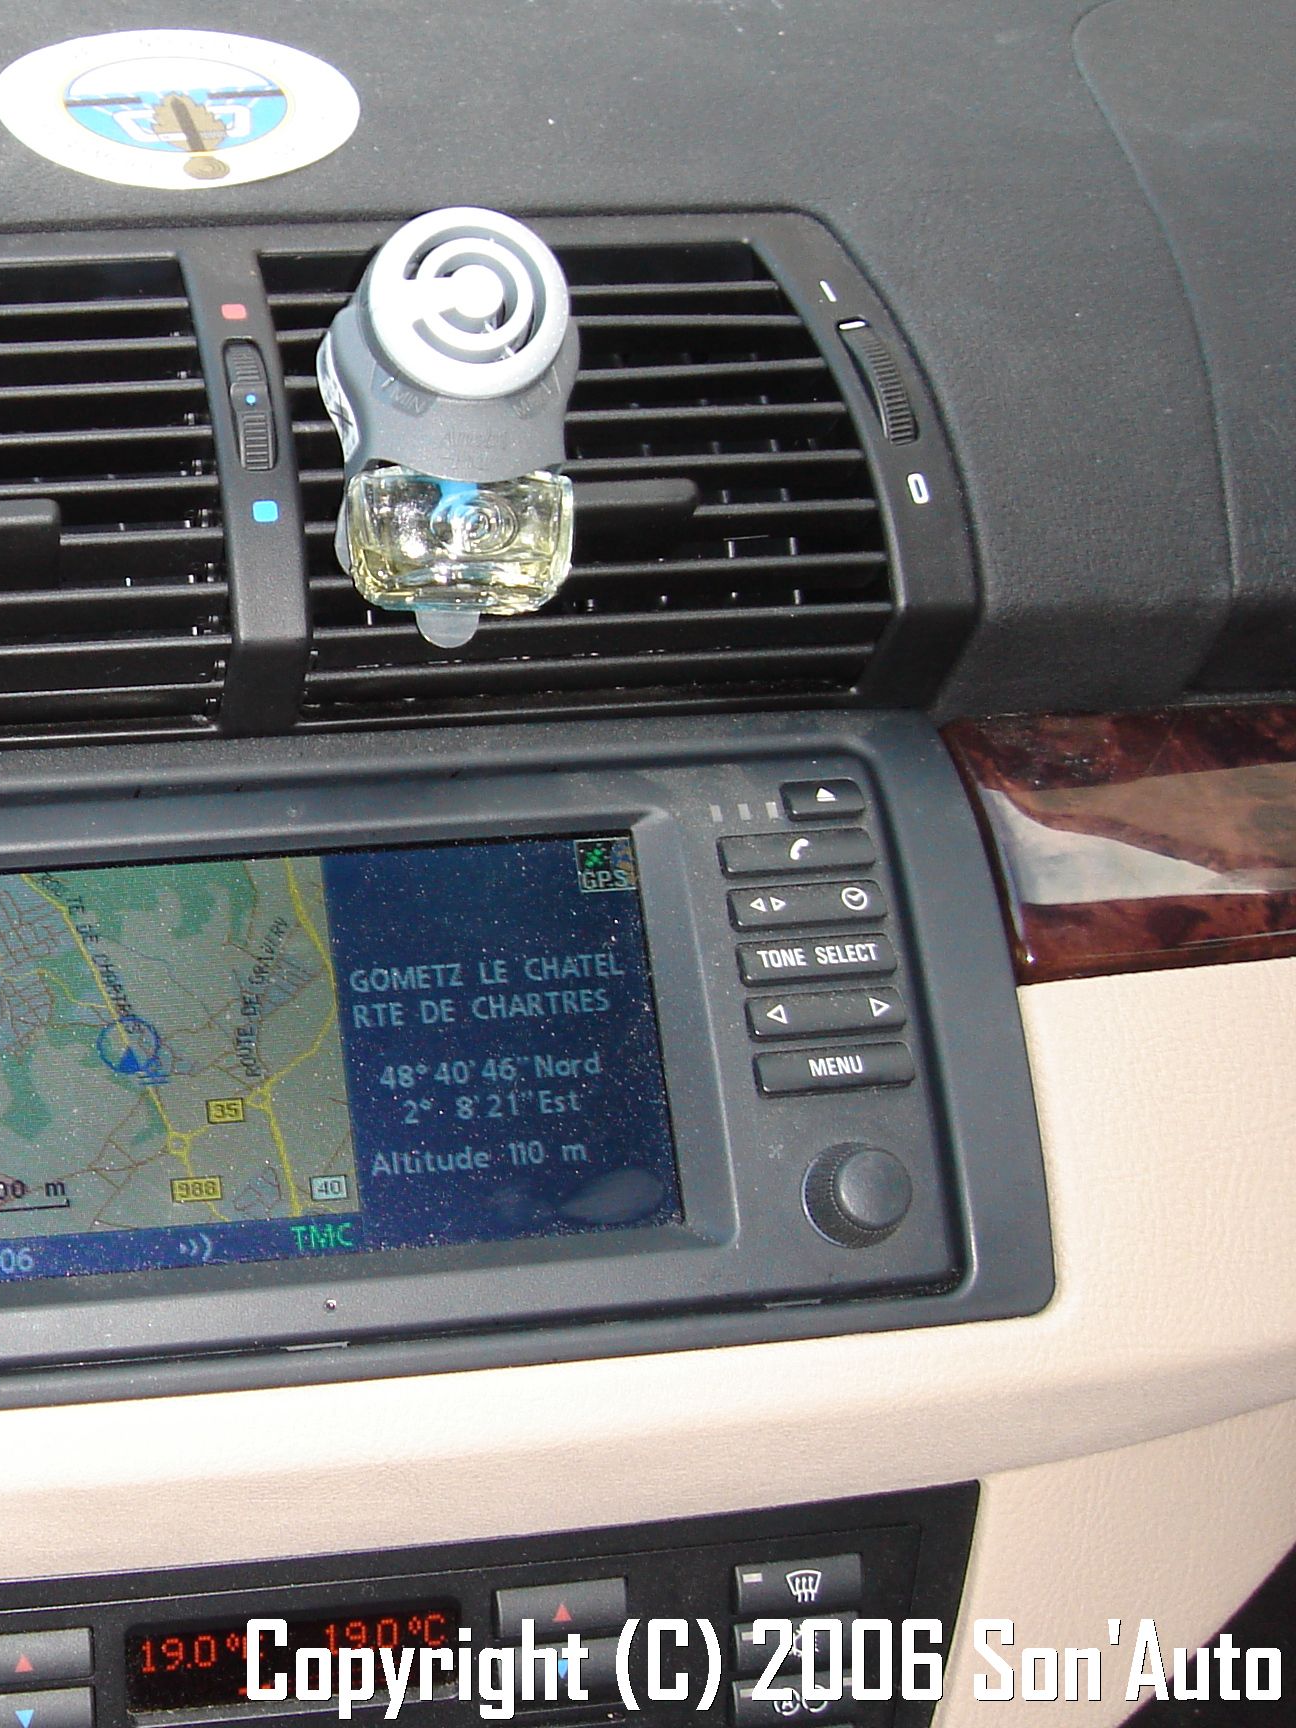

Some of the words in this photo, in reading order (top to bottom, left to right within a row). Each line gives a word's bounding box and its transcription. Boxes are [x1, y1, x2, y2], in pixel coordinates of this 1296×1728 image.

[582, 869, 628, 889] GPS
[756, 947, 807, 968] TONE
[815, 943, 878, 965] SELECT
[349, 963, 465, 993] GOMETZ
[479, 959, 508, 985] LE
[524, 951, 625, 982] CHATEL
[353, 1002, 405, 1029] RTE
[421, 999, 456, 1025] DE
[471, 988, 611, 1020] CHARTRES
[533, 1050, 601, 1079] Nord
[808, 1054, 864, 1077] MENU
[213, 1102, 238, 1119] 35
[538, 1088, 582, 1114] Est
[371, 1145, 491, 1176] Altitude
[508, 1140, 545, 1165] 110
[561, 1143, 588, 1162] m
[45, 1181, 66, 1198] m
[291, 1222, 353, 1251] TMC
